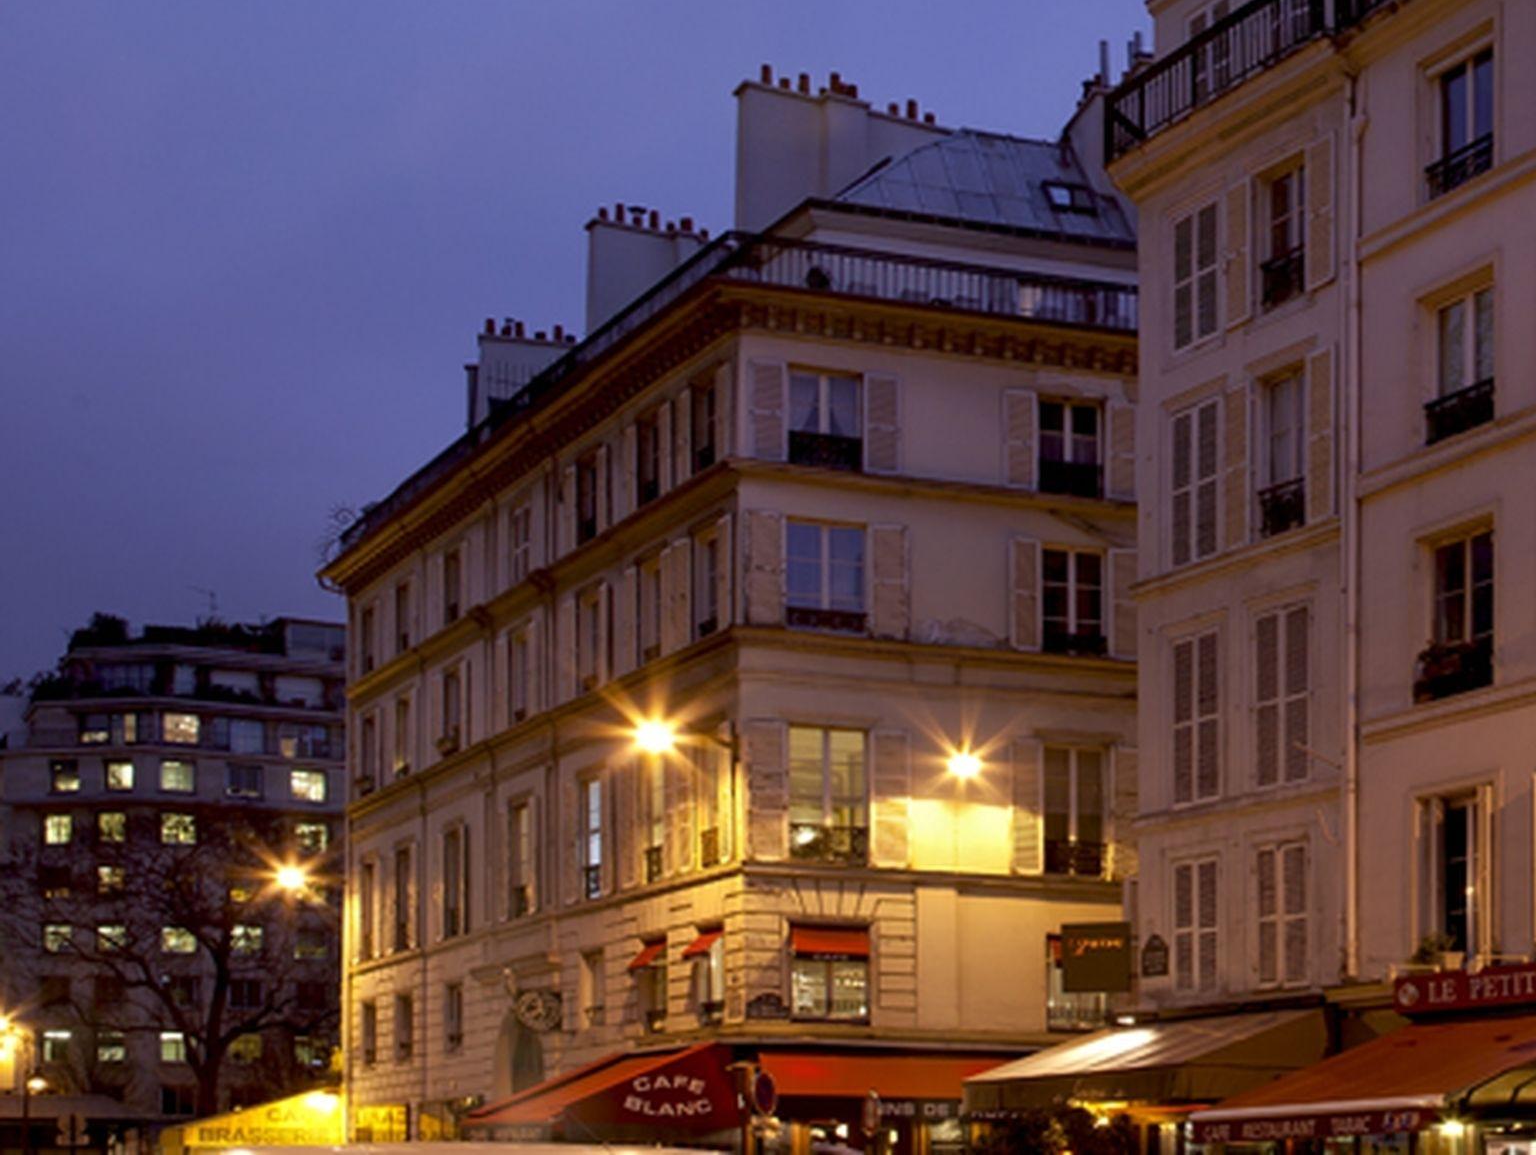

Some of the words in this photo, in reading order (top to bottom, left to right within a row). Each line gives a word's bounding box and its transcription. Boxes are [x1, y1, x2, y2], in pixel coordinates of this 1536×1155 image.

[1428, 978, 1456, 1003] LE
[1470, 971, 1536, 1000] PETIT
[624, 1095, 712, 1116] BLANC
